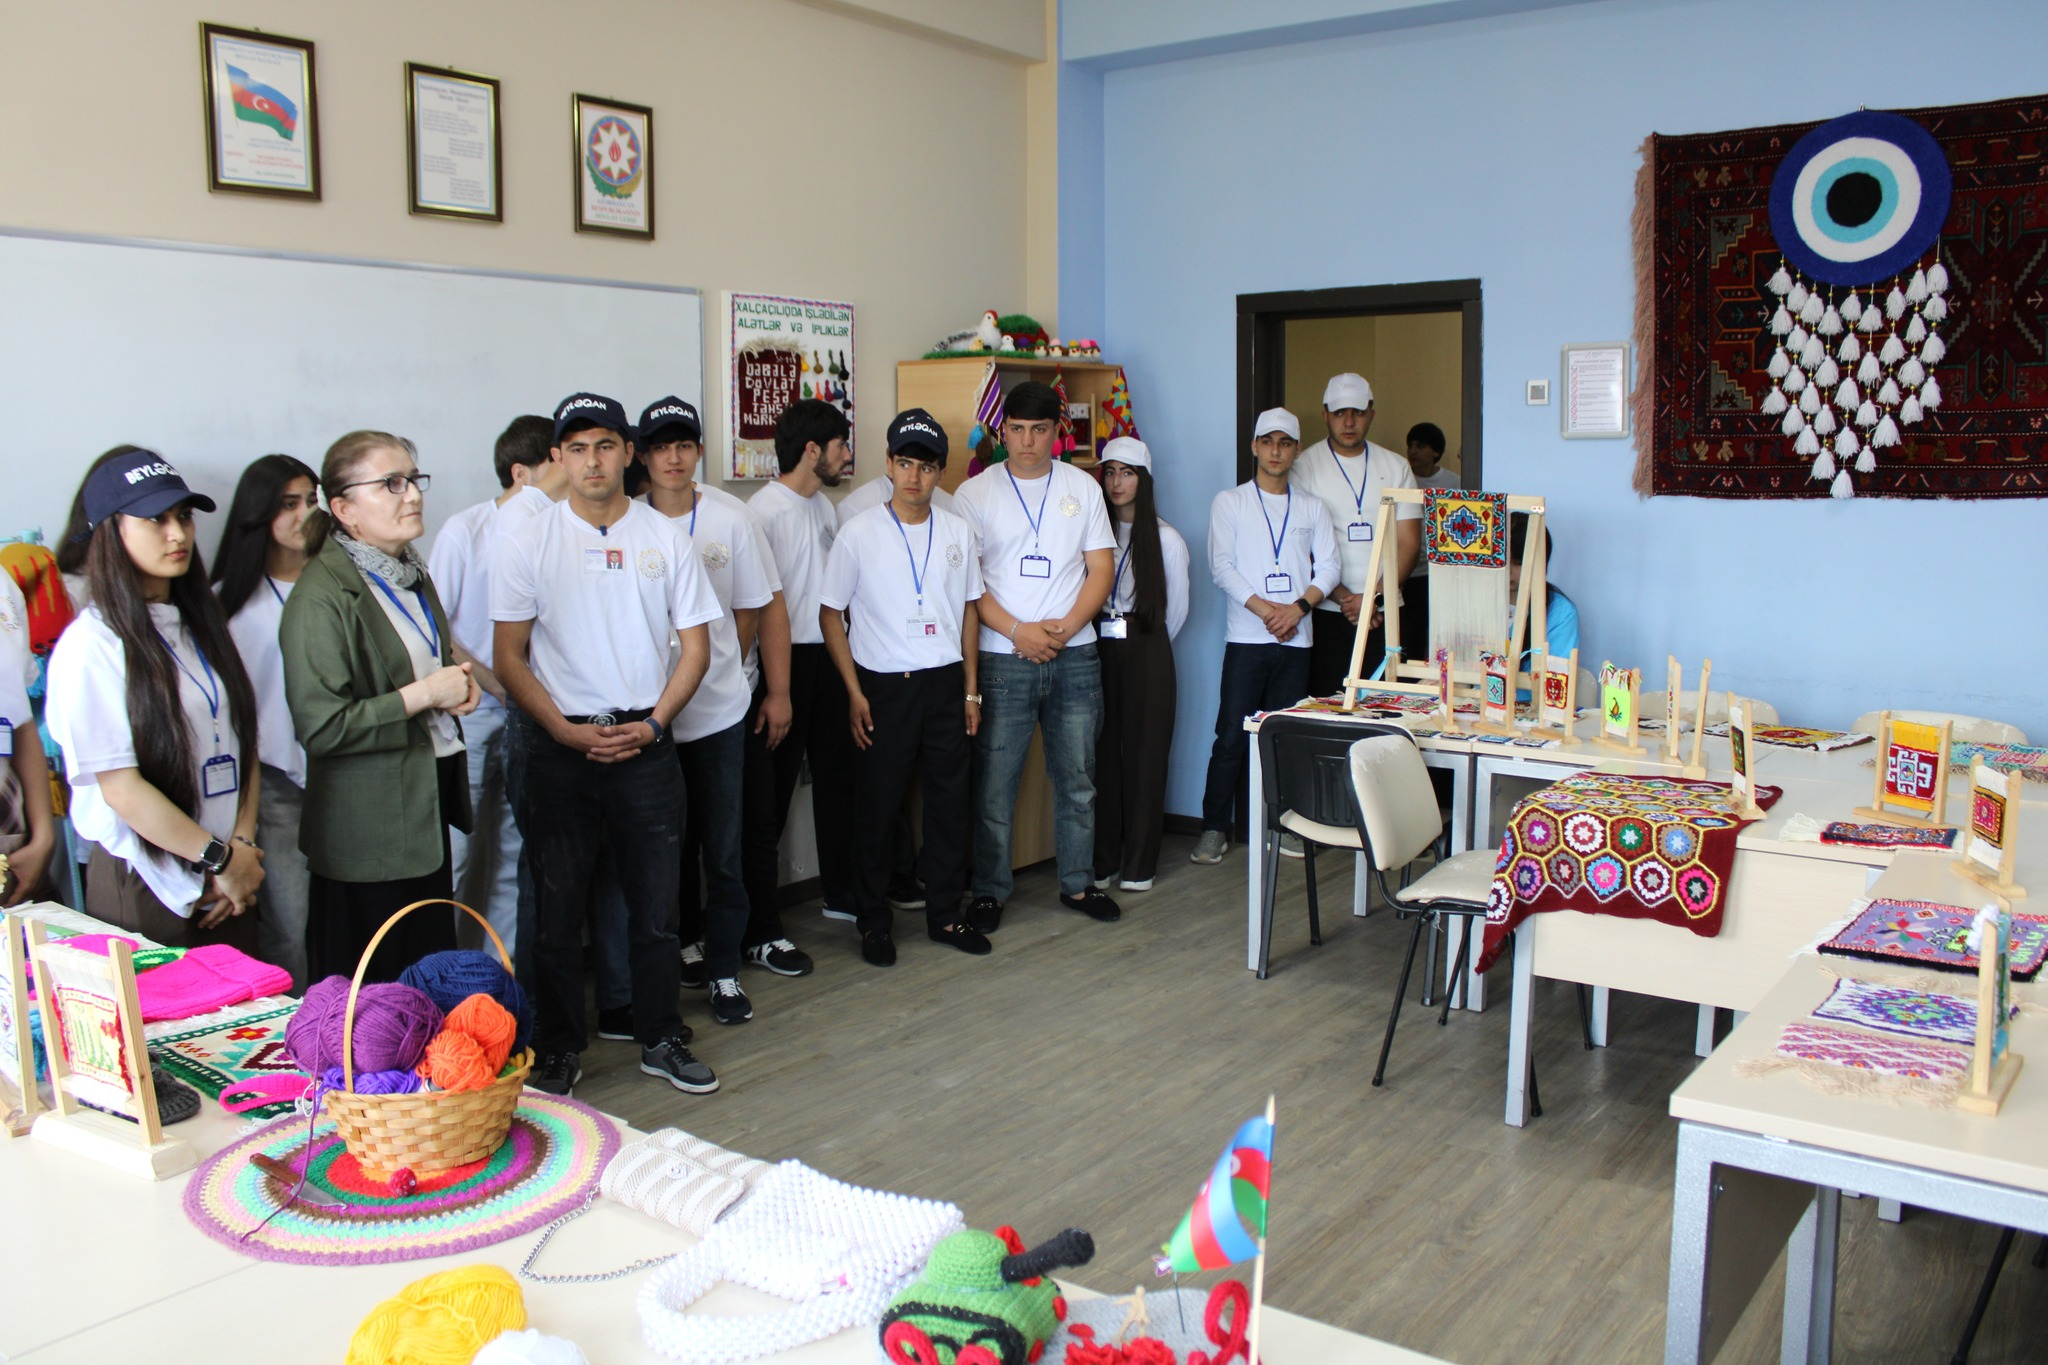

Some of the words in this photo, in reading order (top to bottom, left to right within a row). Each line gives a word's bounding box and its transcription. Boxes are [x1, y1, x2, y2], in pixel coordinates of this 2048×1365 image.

[738, 317, 781, 331] ALƏTLƏR
[790, 321, 803, 333] VƏ
[650, 405, 694, 420] BEYLƏQAN
[752, 402, 790, 415] TƏHS
[124, 462, 180, 485] BEYLƏQ
